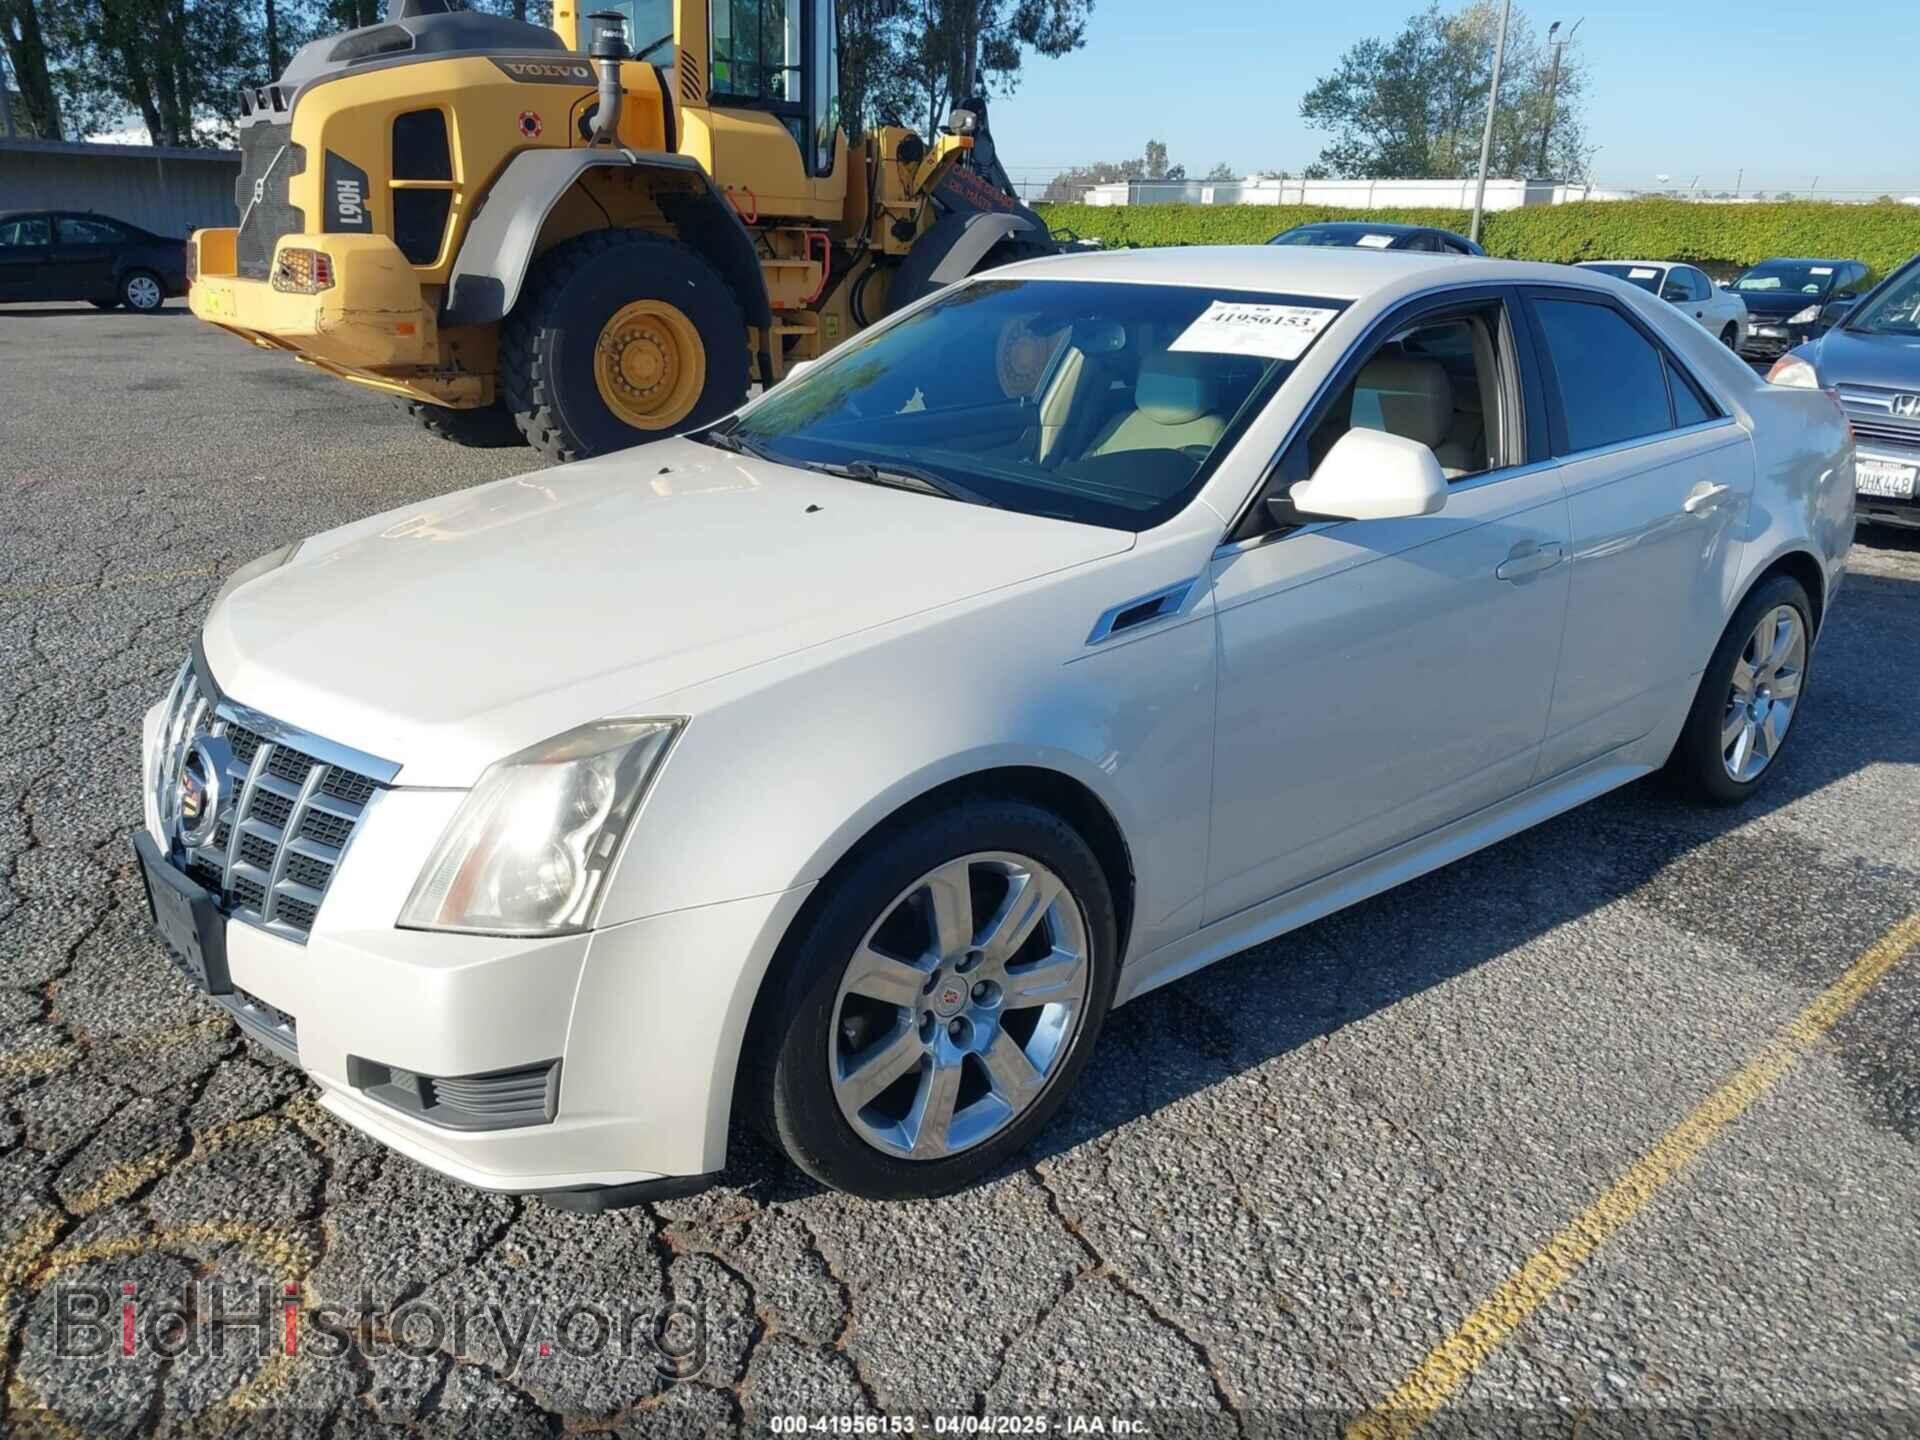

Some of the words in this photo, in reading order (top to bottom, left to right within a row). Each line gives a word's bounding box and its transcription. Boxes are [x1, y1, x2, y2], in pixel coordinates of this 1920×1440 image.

[504, 63, 589, 78] VOLVO
[336, 180, 363, 225] L90H
[1210, 312, 1312, 328] 41956153
